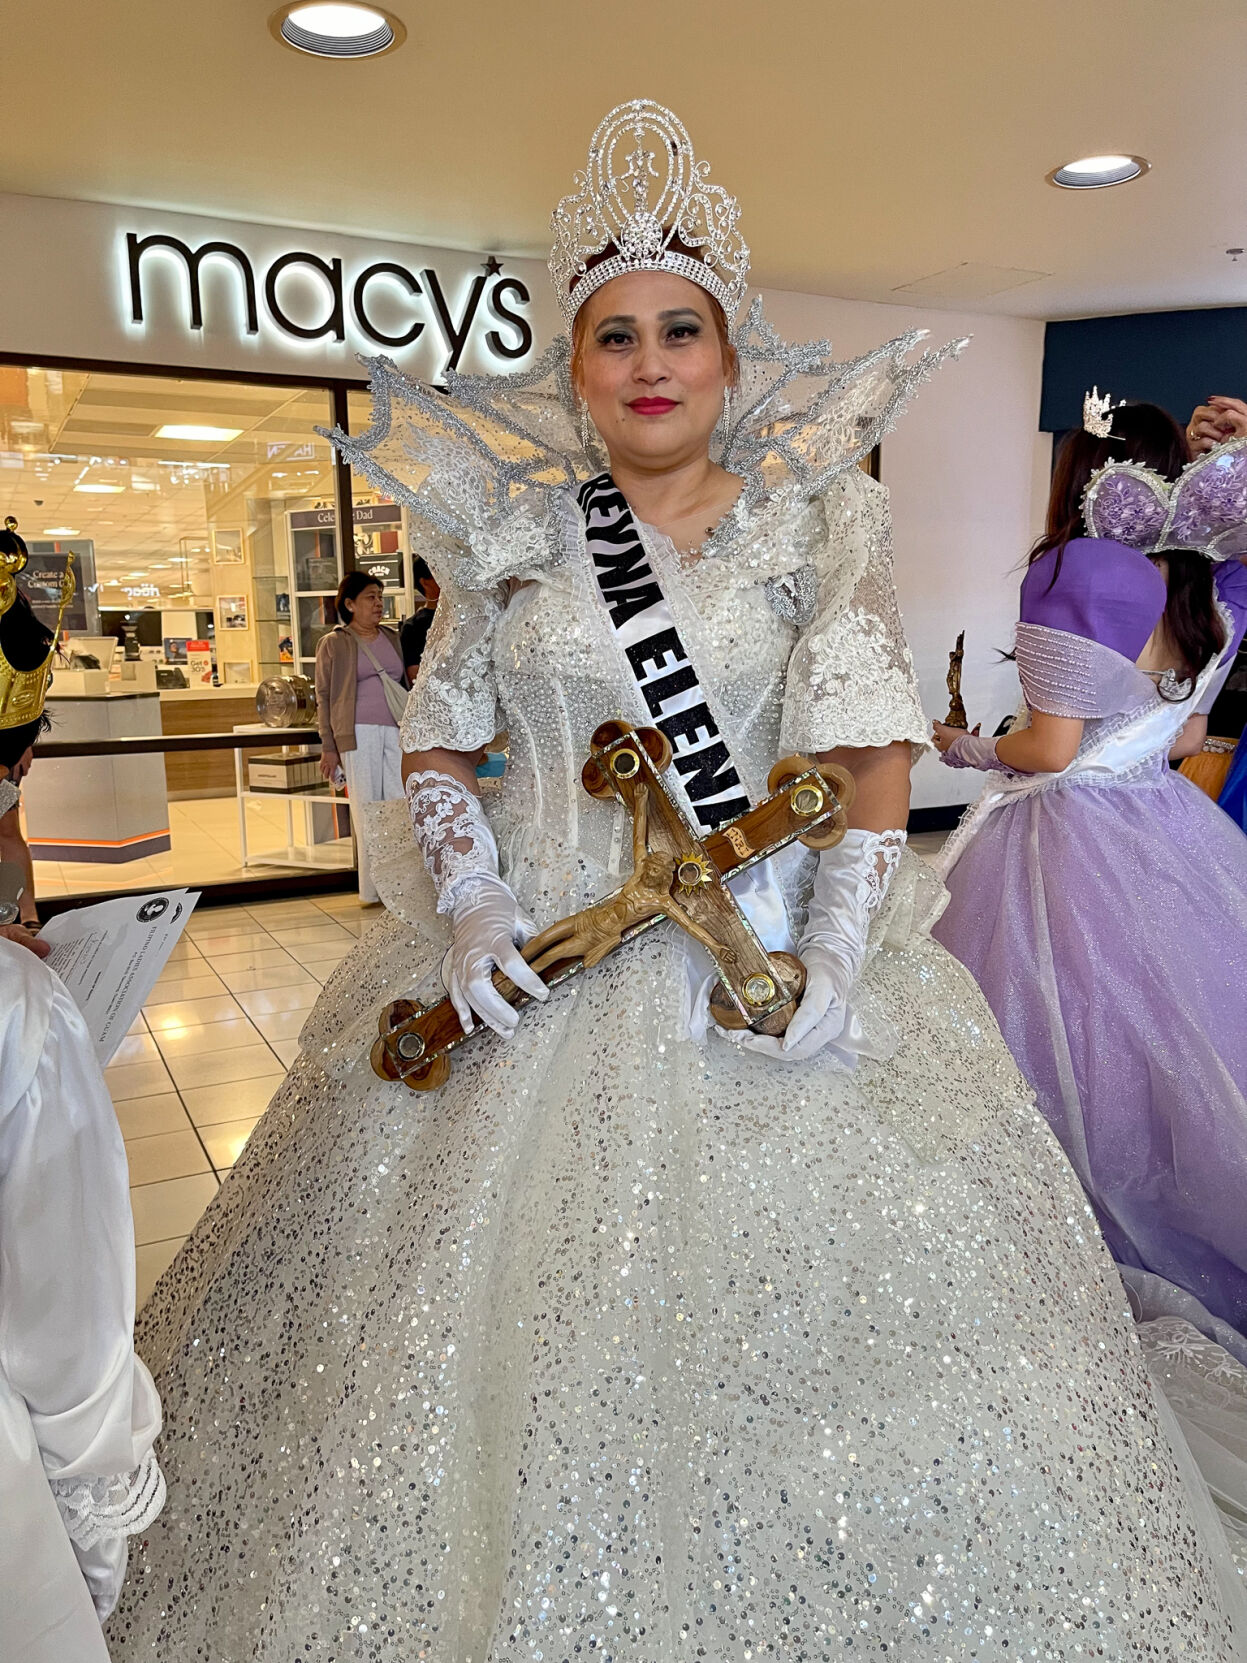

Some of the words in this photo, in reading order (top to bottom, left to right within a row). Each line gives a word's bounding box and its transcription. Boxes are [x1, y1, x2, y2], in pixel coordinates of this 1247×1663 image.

[356, 509, 373, 520] Dad
[576, 472, 665, 630] REYNA
[32, 570, 58, 579] Create
